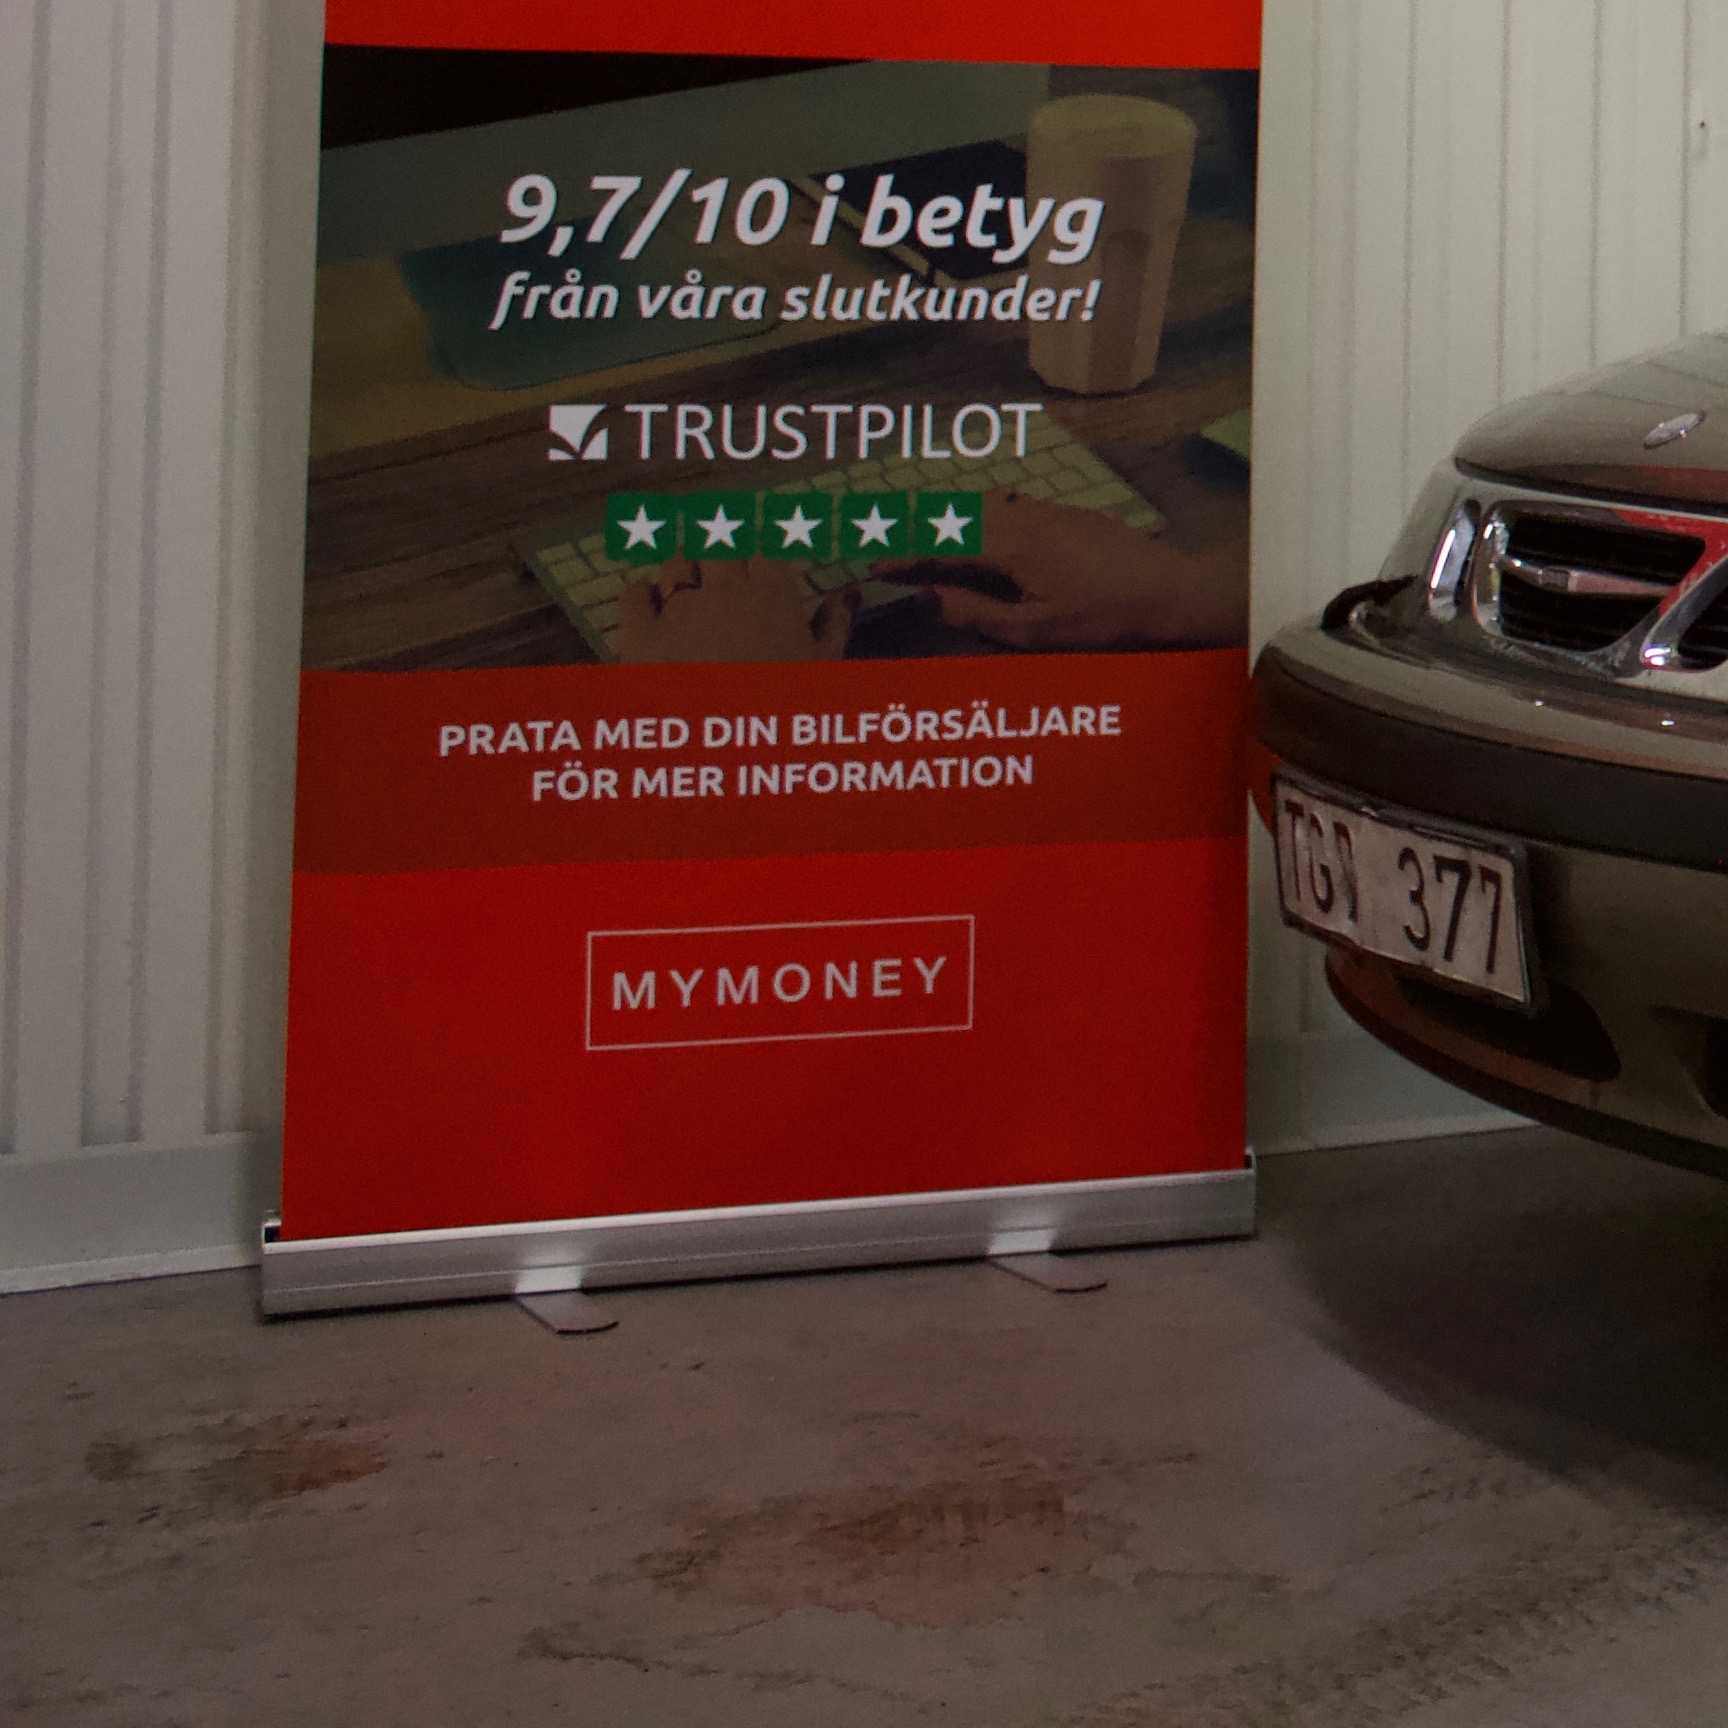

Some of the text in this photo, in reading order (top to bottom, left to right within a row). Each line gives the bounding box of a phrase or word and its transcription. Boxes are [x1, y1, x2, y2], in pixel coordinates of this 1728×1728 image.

[502, 169, 1103, 264] 9,7/10 i betyg
[490, 269, 1100, 329] från våra slutkunder!
[625, 403, 1043, 459] TRUSTPILOT
[440, 699, 1121, 756] PRATA MED DIN BILFÖRSÄLJARE
[533, 755, 1032, 801] FÖR MER INFORMATION
[1397, 846, 1504, 975] 377
[613, 957, 946, 1010] MYMONEY
